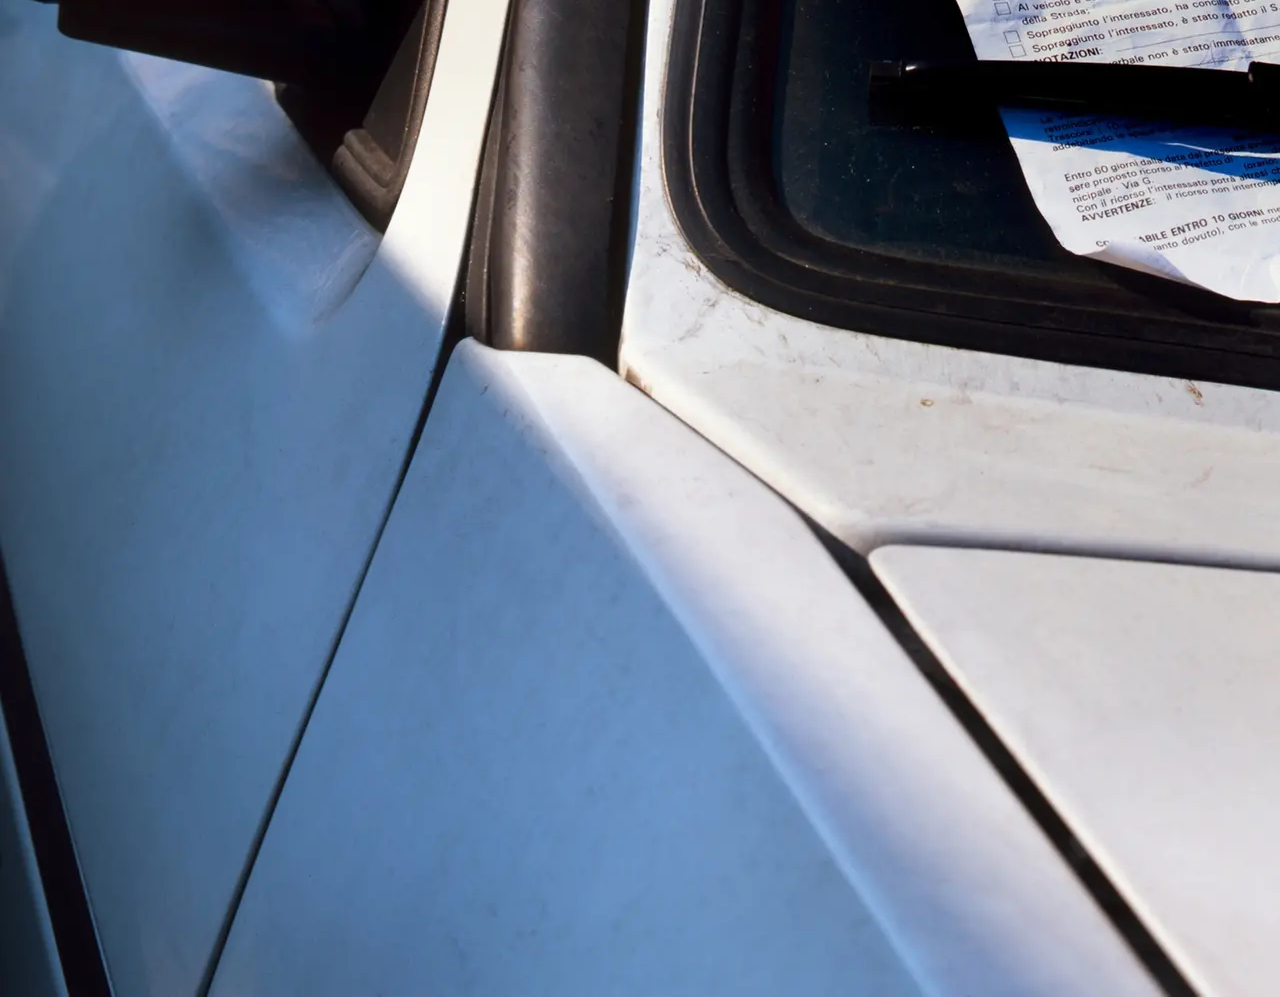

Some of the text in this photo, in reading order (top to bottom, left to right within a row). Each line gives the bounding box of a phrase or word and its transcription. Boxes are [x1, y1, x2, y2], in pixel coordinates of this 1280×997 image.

[1018, 3, 1029, 12] Al
[1033, 0, 1070, 11] veicolo
[1022, 8, 1090, 25] della Strada;
[1026, 19, 1100, 40] Sopraggiunto
[1103, 6, 1172, 23] l'interessato,
[1176, 2, 1189, 10] ha
[1064, 152, 1201, 182] Entro 60 giorni dalla data del
[1068, 183, 1090, 193] sere
[1093, 171, 1137, 190] proposto
[1139, 166, 1172, 178] ricorso
[1184, 159, 1221, 170] Prefetto
[1223, 157, 1233, 165] di
[1076, 175, 1236, 213] Con il ricorso l'interessato potrà
[1081, 197, 1156, 222] AVVERTENZE:
[1175, 188, 1209, 199] ricorso
[1211, 186, 1230, 194] non
[1171, 219, 1208, 238] ENTRO
[1212, 214, 1225, 224] 10
[1228, 209, 1265, 222] GIORNI
